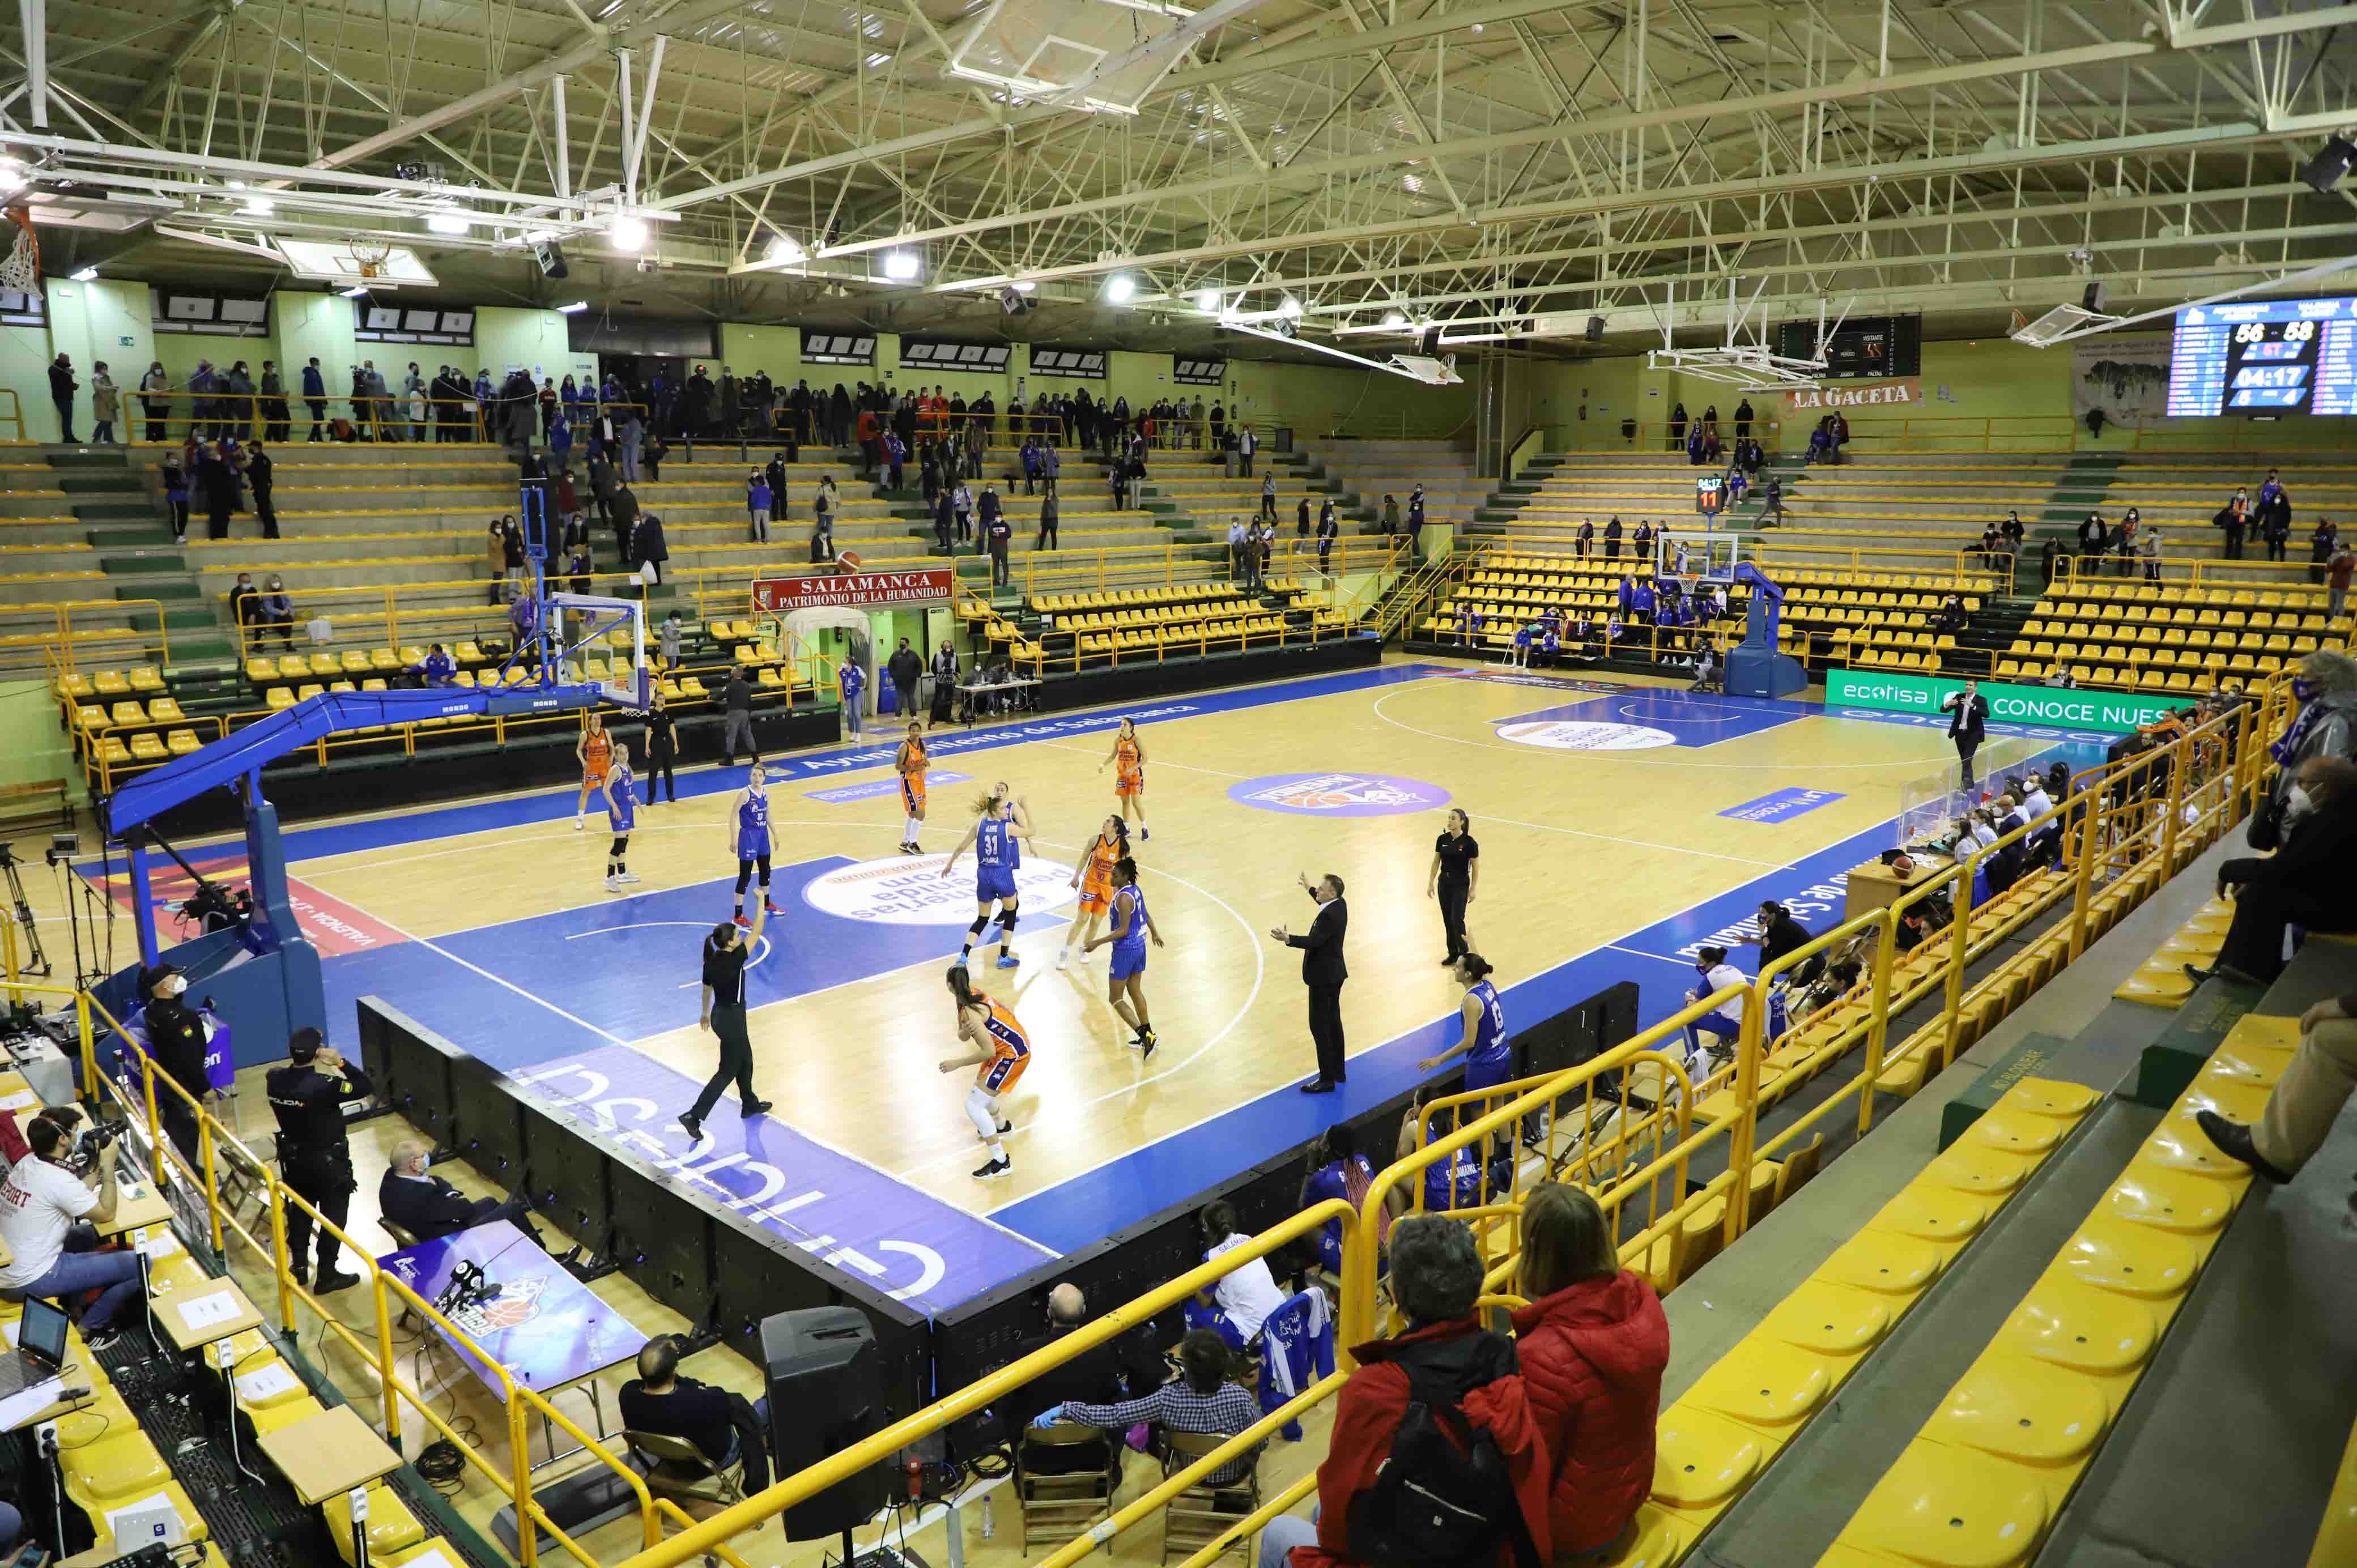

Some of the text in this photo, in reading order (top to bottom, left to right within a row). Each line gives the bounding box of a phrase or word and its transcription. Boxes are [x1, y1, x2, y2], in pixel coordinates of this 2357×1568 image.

[2235, 321, 2315, 343] 56 58
[2238, 368, 2302, 387] 04:17
[1794, 385, 1911, 407] LA GACETA
[1700, 492, 1717, 508] 11
[801, 573, 931, 594] SALAMANCA
[779, 586, 948, 608] PATRIMONIO DE LA HUMANIDAD
[442, 704, 469, 713] MONDO
[533, 699, 558, 708] MONDO
[1993, 697, 2095, 722] CONOCE
[1024, 725, 1057, 735] de
[1056, 705, 1199, 730] Salamanca
[984, 835, 998, 856] 31
[1809, 884, 1847, 901] de
